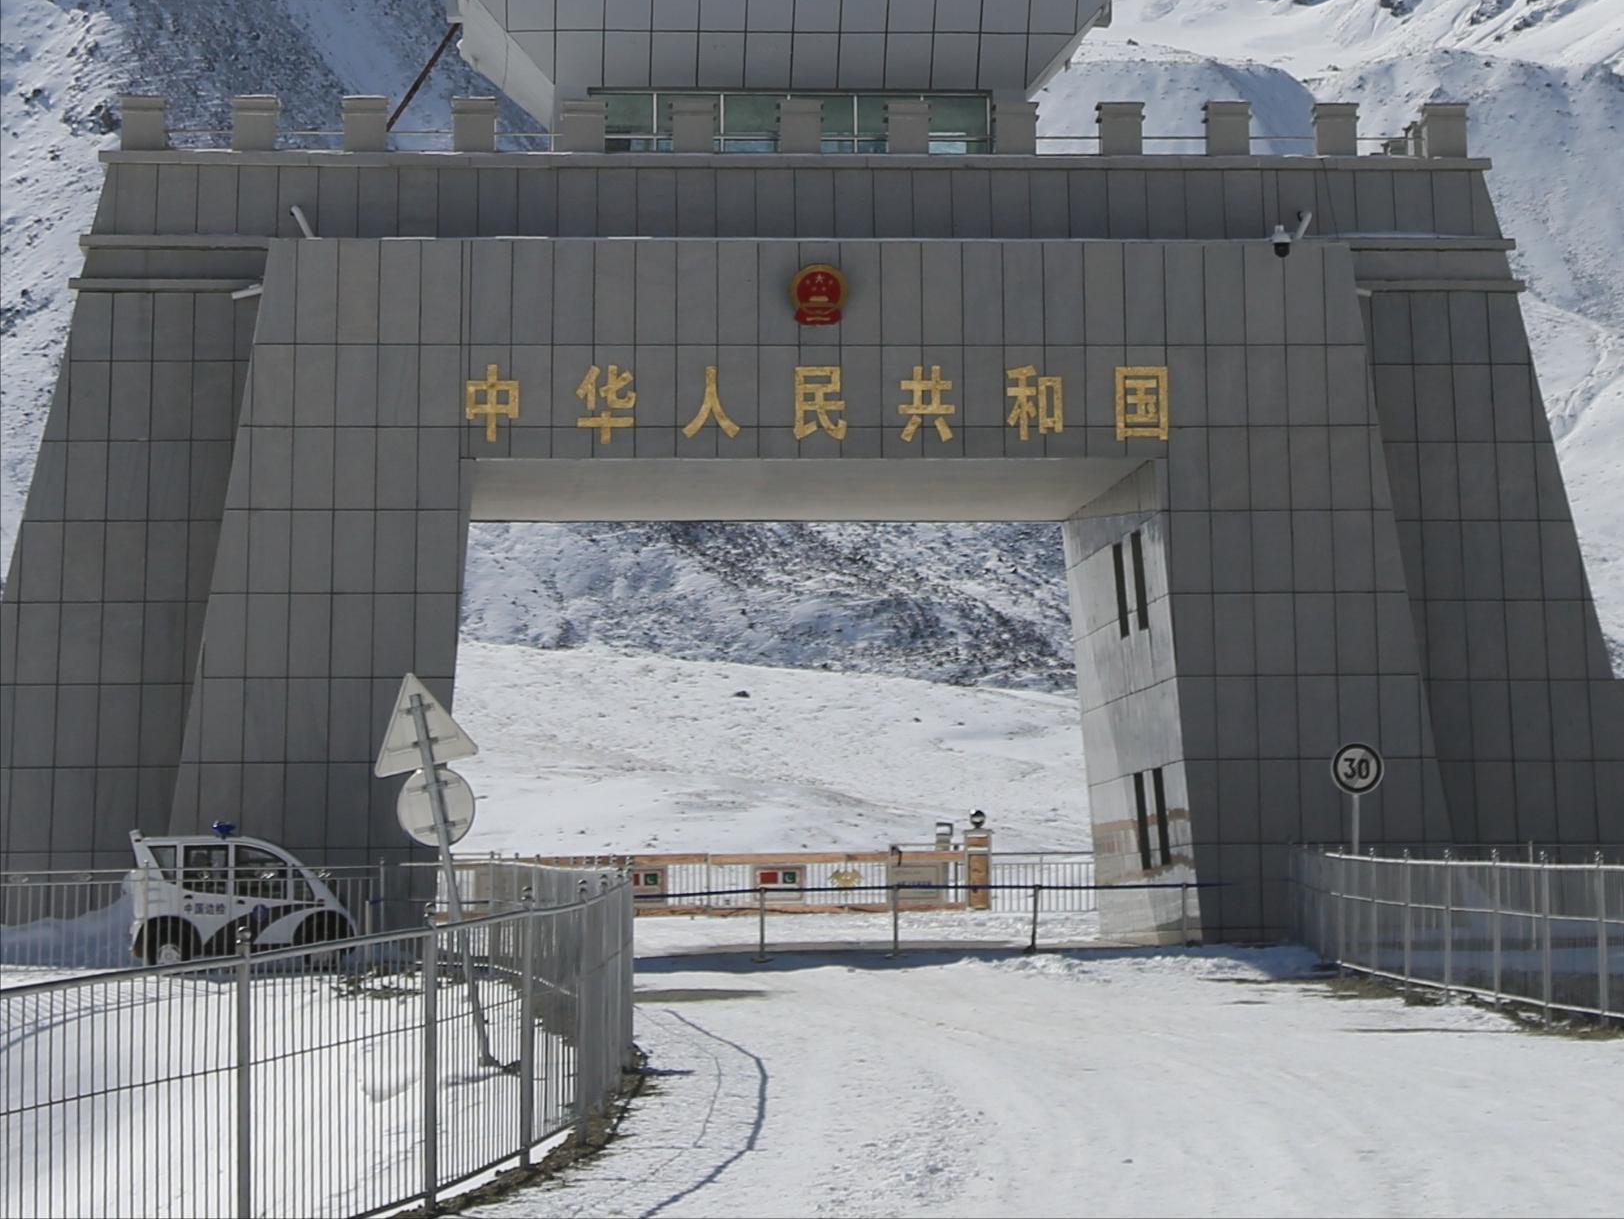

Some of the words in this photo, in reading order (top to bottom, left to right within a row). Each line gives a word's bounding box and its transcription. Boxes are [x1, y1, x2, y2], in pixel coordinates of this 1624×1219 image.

[465, 364, 1168, 444] 中华人民共和国
[1343, 757, 1370, 780] 30
